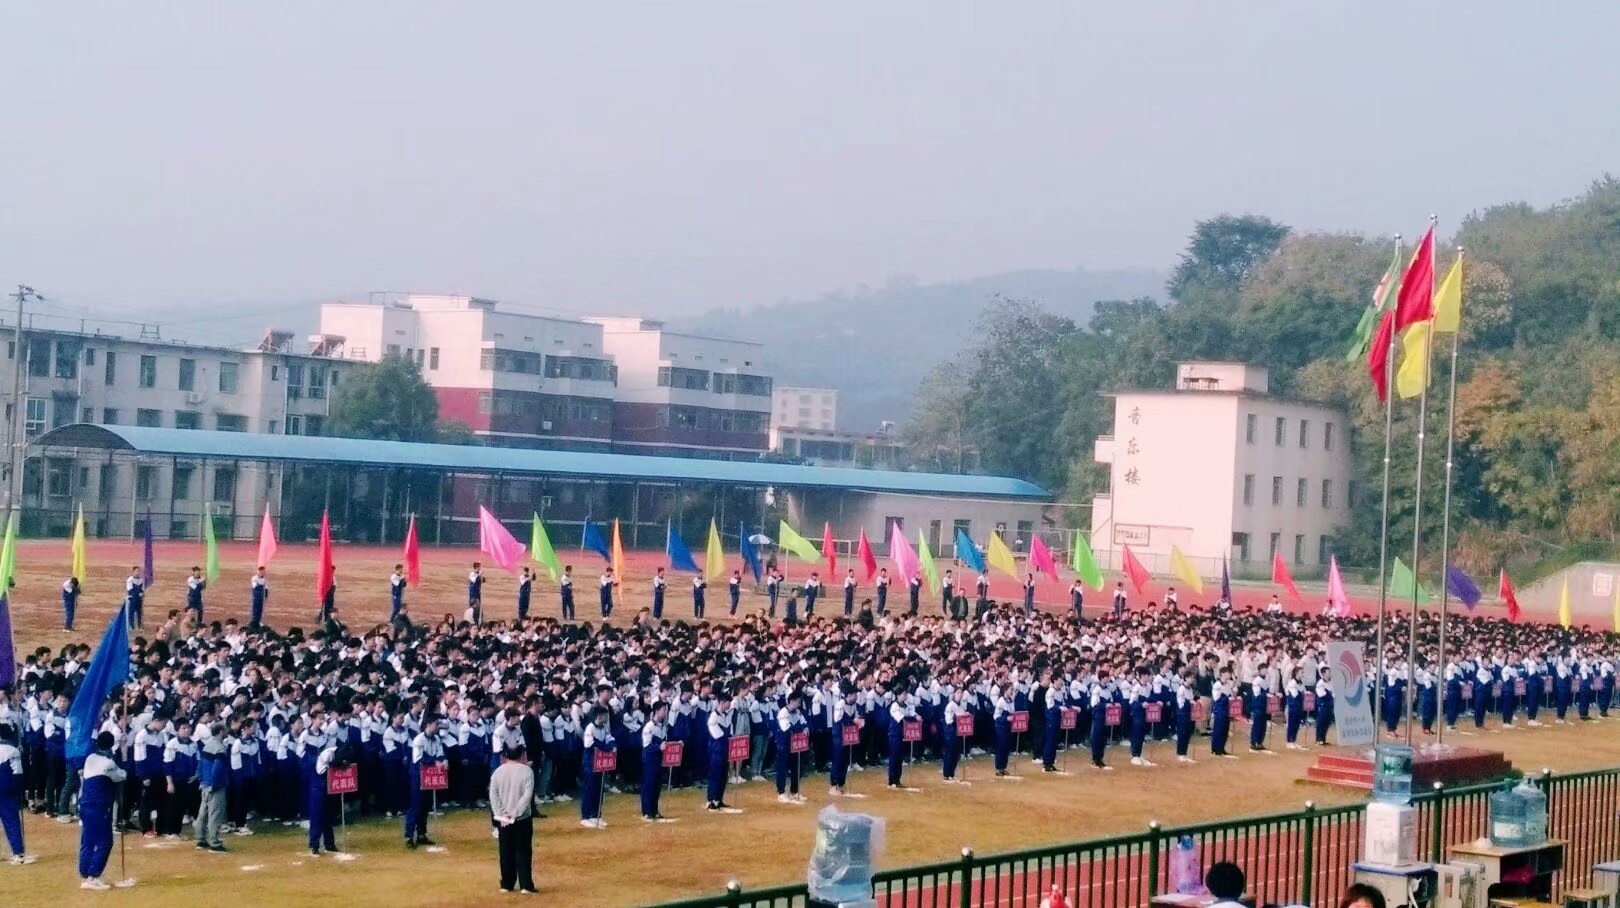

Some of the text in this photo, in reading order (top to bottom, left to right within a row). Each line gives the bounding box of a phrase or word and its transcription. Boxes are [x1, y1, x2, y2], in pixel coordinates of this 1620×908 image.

[1124, 406, 1141, 486] 音乐楼
[332, 777, 355, 790] 代表队
[424, 775, 446, 786] 代表队
